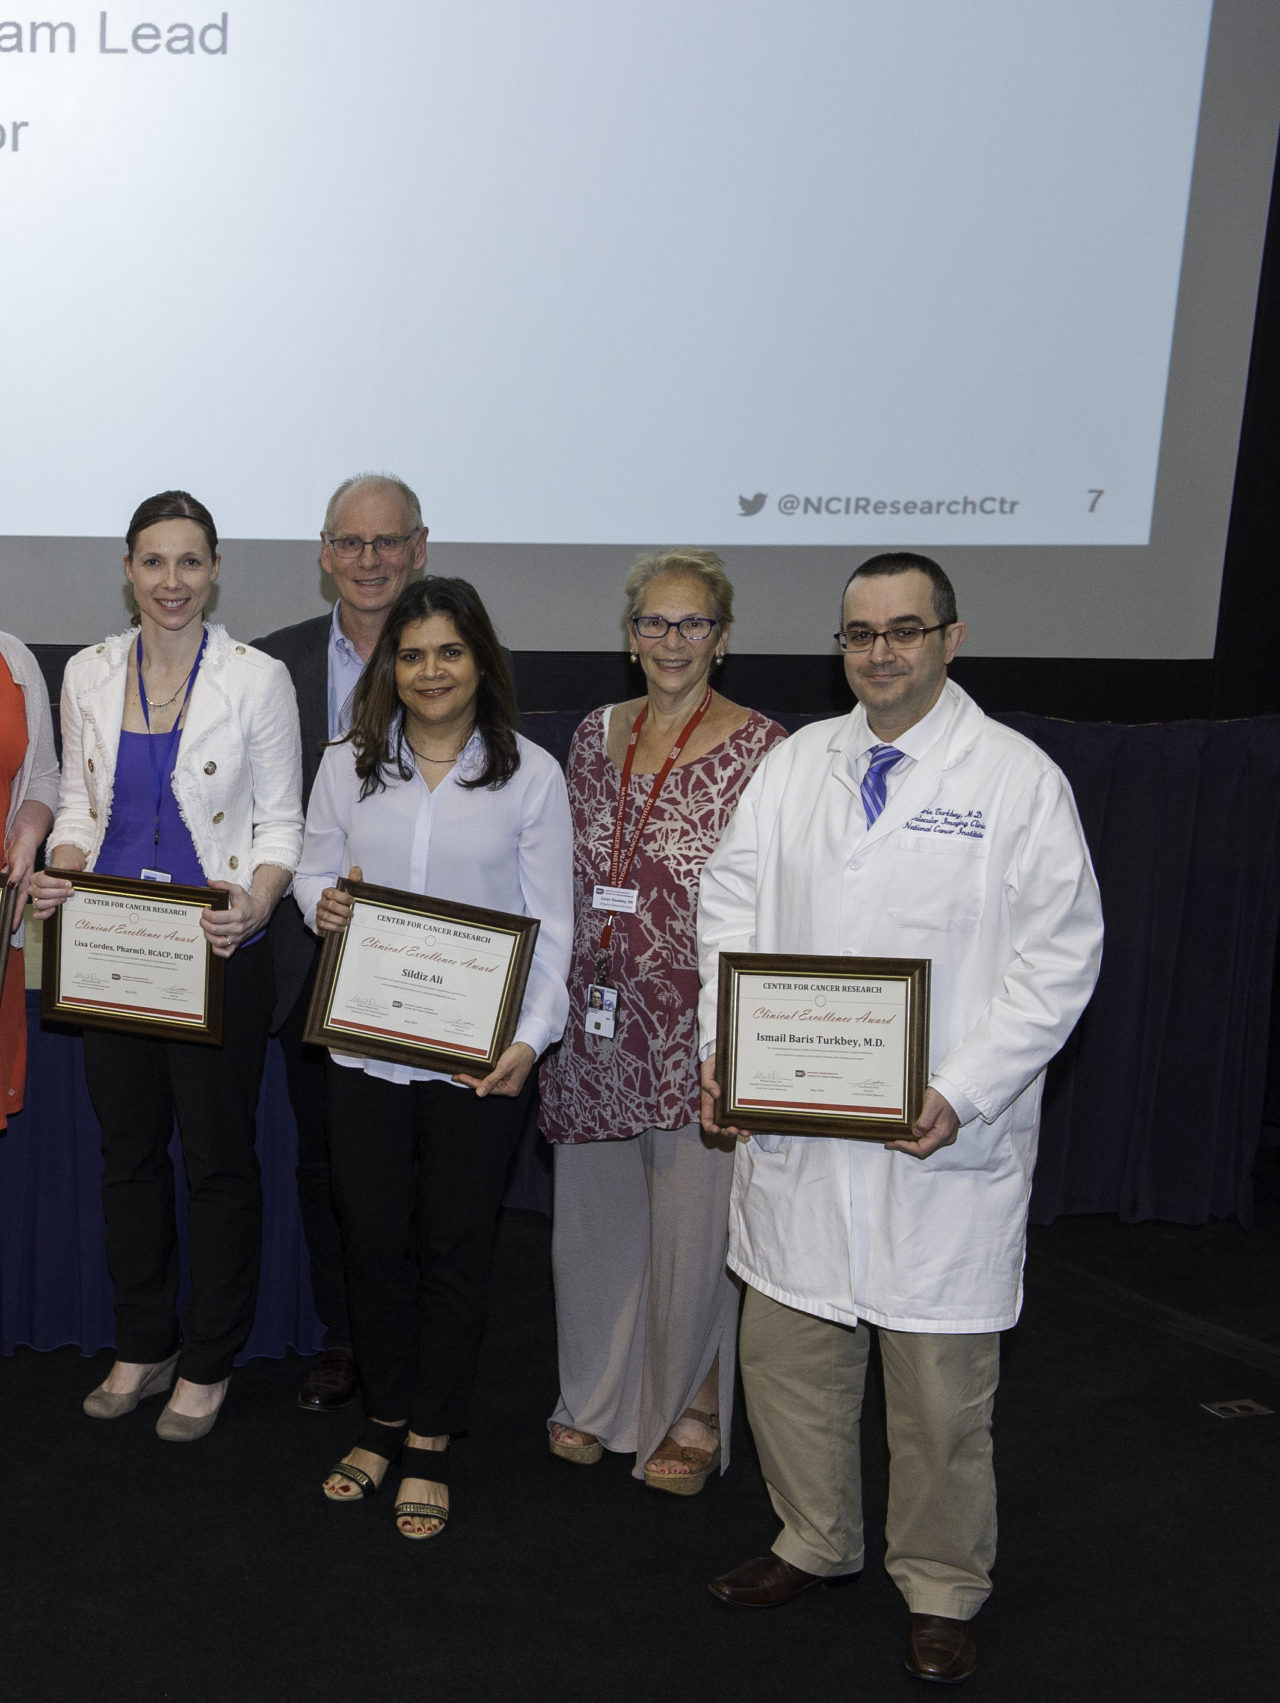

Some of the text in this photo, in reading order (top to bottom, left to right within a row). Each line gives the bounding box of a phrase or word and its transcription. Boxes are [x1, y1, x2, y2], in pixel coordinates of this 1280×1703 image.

[98, 11, 229, 55] Lead
[778, 494, 1019, 517] @NCIResearchCtr
[1087, 489, 1105, 513] 7
[628, 830, 640, 856] CANCER
[639, 798, 654, 830] INSTITUTE
[911, 815, 939, 823] olecular
[610, 786, 626, 886] NATIONAL CANCER INSTITUTE
[84, 898, 110, 907] CENTER
[125, 903, 151, 912] CANCER
[153, 906, 187, 917] RESEARCH
[74, 919, 199, 944] Clinical Excellence Award
[377, 914, 491, 944] CENTER FOR CANCER RESEARCH
[89, 941, 115, 952] Cordes,
[117, 945, 146, 956] PharmD,
[148, 949, 173, 959] BCACP,
[175, 953, 193, 961] BCOP
[360, 936, 500, 974] Clinical Excellence Award
[402, 968, 443, 984] Sildiz Ali
[763, 982, 882, 994] CENTER FOR CANCER RESEARCH
[752, 1007, 896, 1025] Clinical Excellence Award
[756, 1033, 885, 1048] Ismail Baris Turkbey, M.D.
